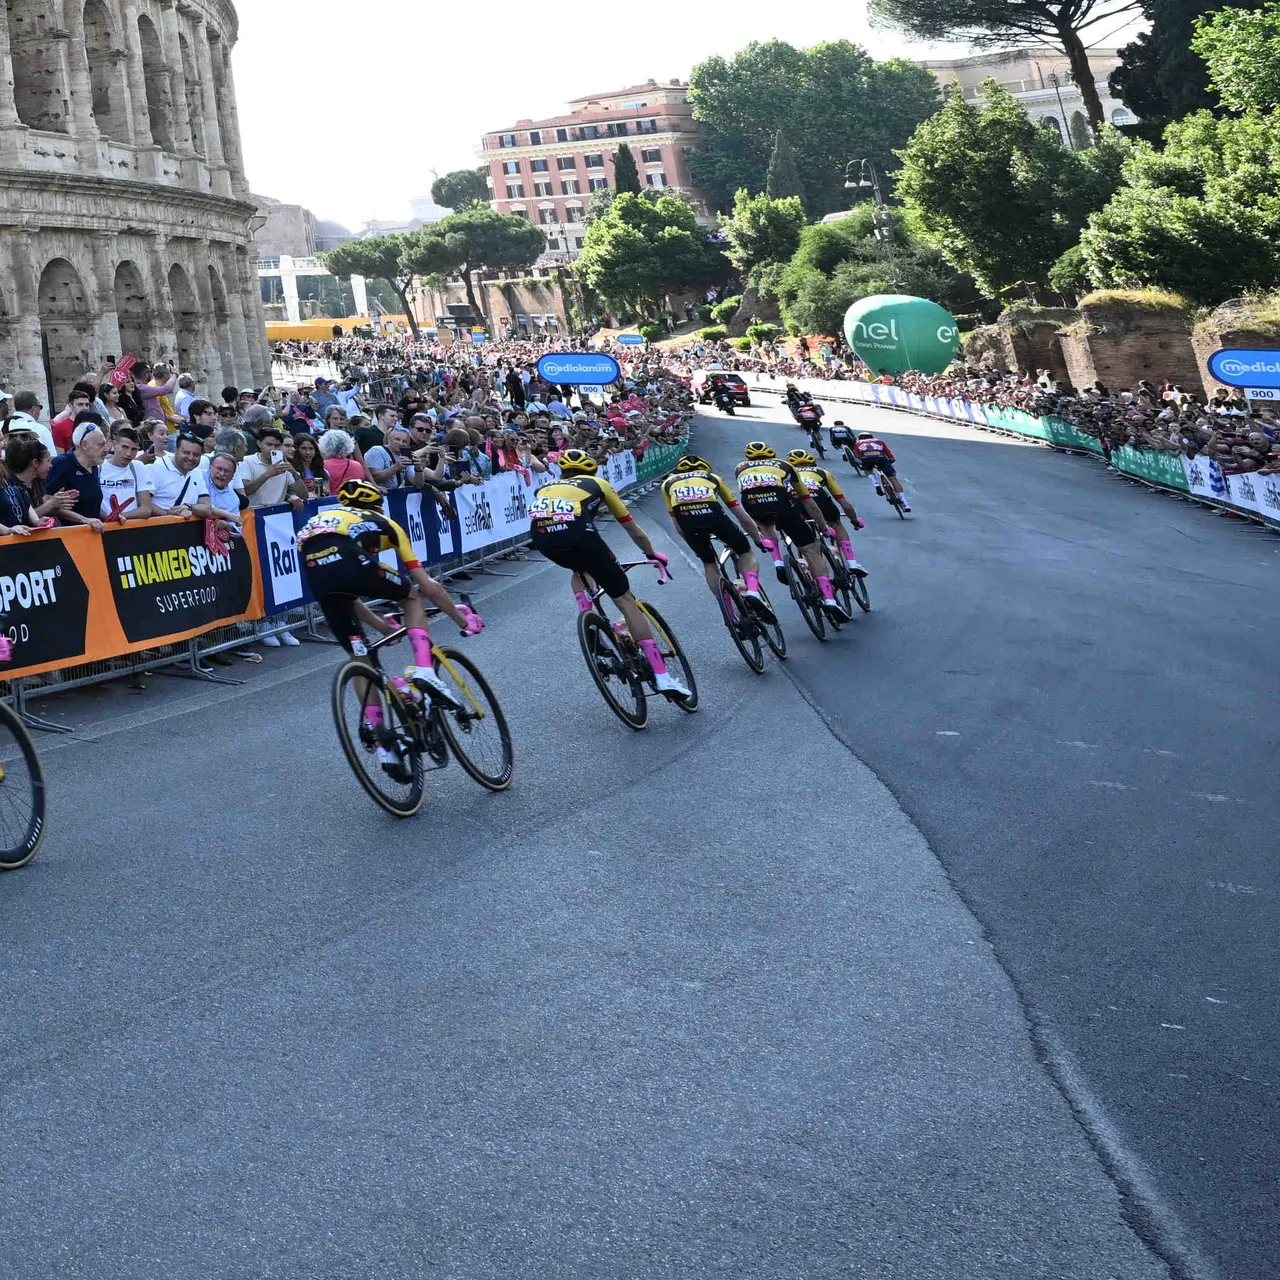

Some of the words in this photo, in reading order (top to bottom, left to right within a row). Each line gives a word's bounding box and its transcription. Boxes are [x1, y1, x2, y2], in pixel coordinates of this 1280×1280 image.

[855, 319, 899, 341] nel
[545, 362, 613, 373] mediolanum
[1251, 390, 1274, 398] 900
[551, 499, 574, 513] 145
[271, 536, 298, 578] Rai
[156, 586, 217, 613] SUPERFOOD
